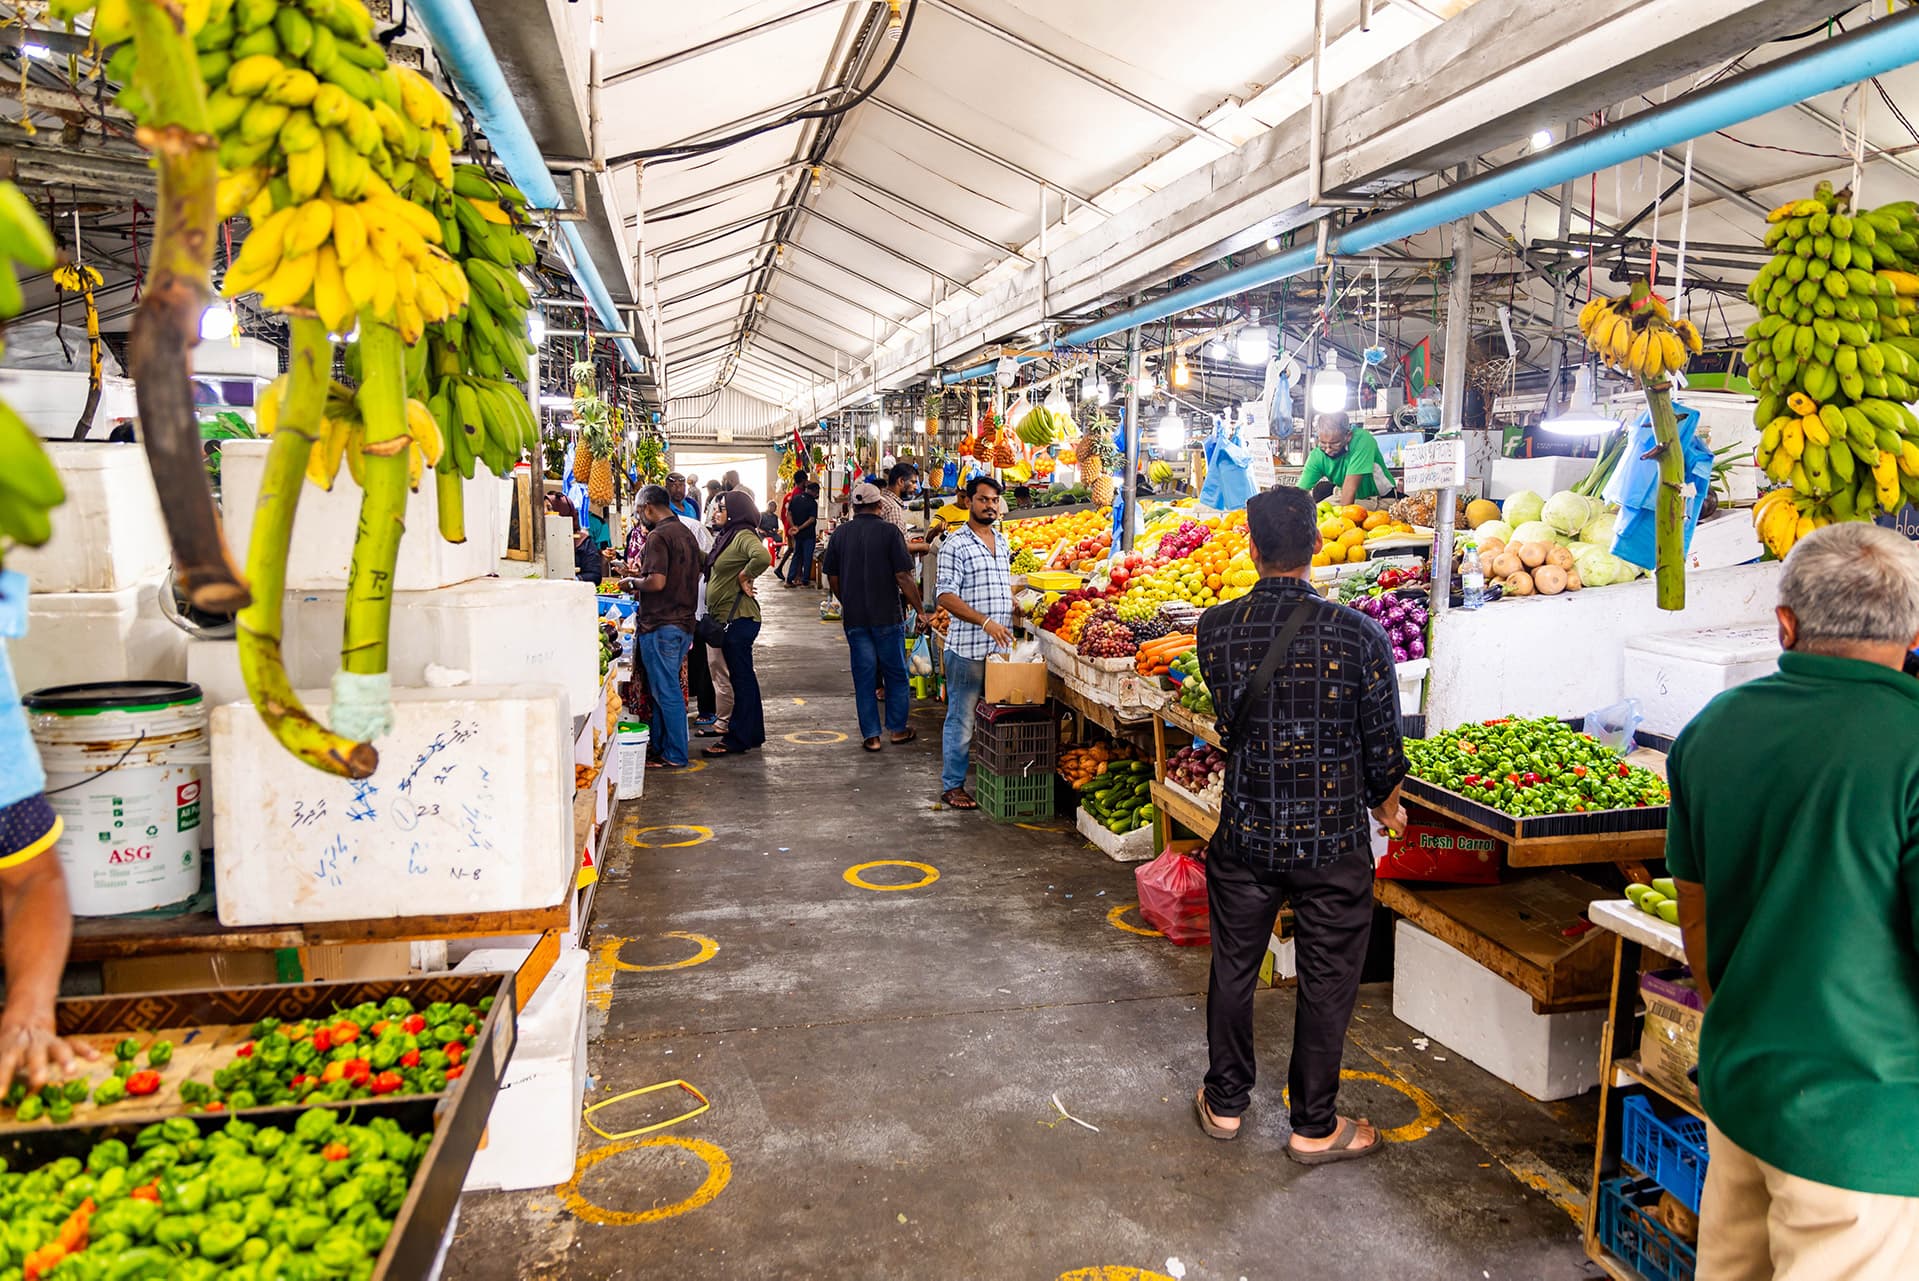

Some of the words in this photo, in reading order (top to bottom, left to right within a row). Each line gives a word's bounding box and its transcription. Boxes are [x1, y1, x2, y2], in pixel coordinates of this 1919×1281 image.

[1420, 833, 1454, 849] Fresh
[108, 845, 152, 864] ASG
[450, 867, 483, 880] N-8
